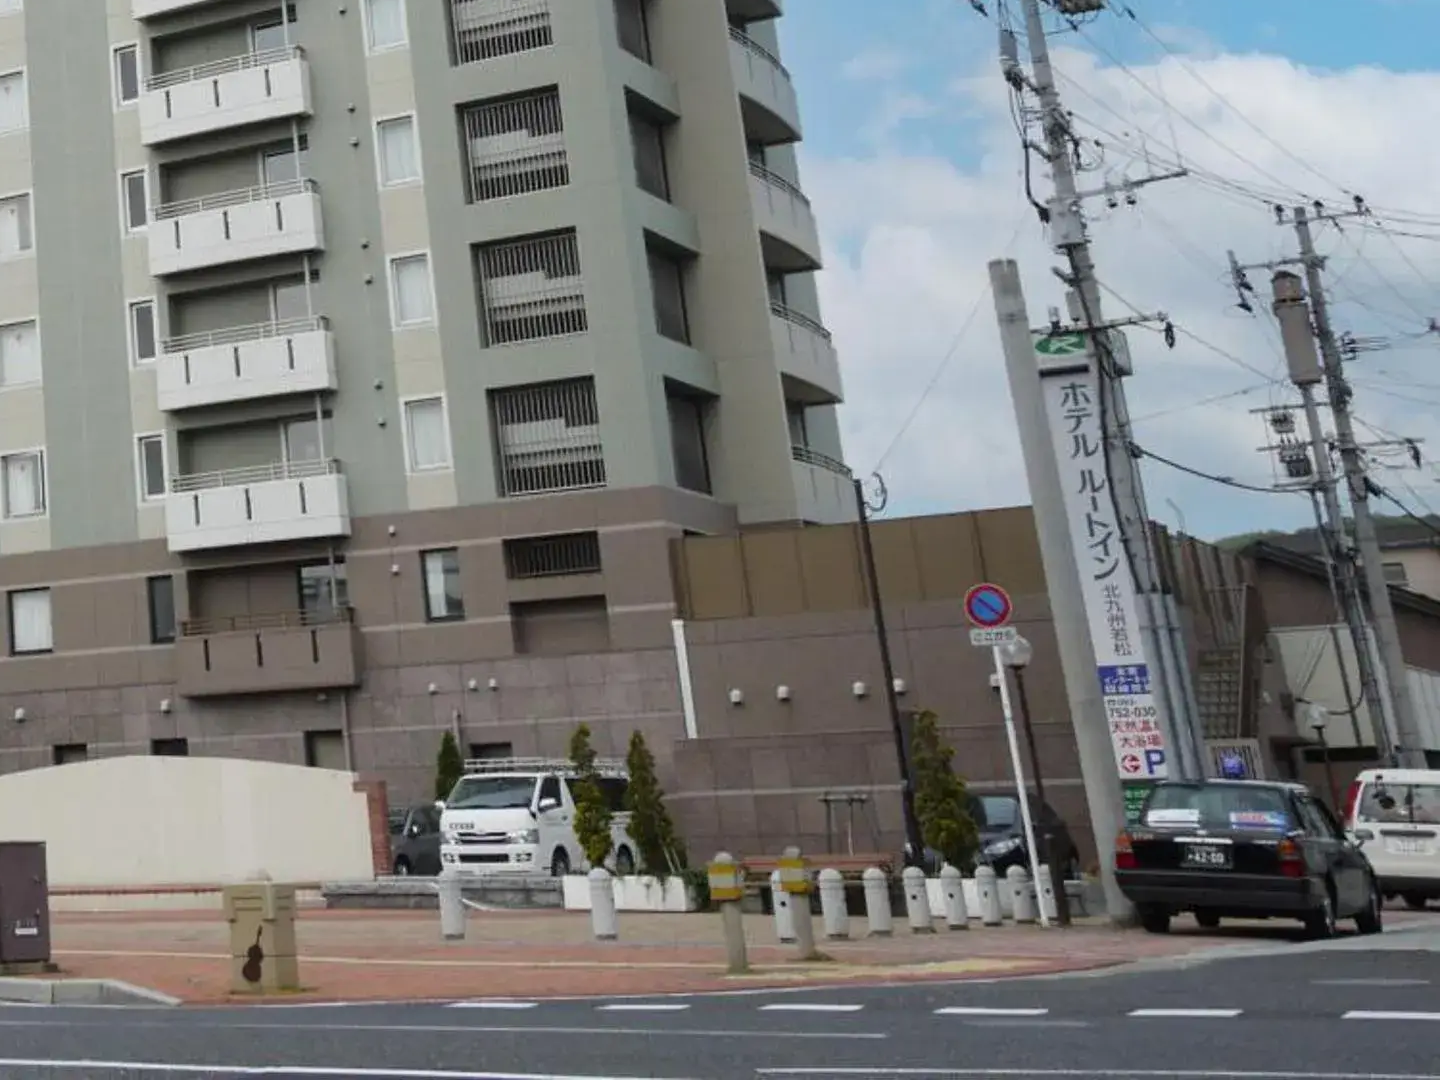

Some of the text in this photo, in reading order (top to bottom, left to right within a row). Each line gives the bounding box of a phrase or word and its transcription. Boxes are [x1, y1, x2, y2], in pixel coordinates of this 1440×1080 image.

[1061, 382, 1100, 459] ホテル
[1079, 470, 1120, 581] ルートイン
[1109, 706, 1156, 718] 752-030
[1145, 749, 1166, 775] P
